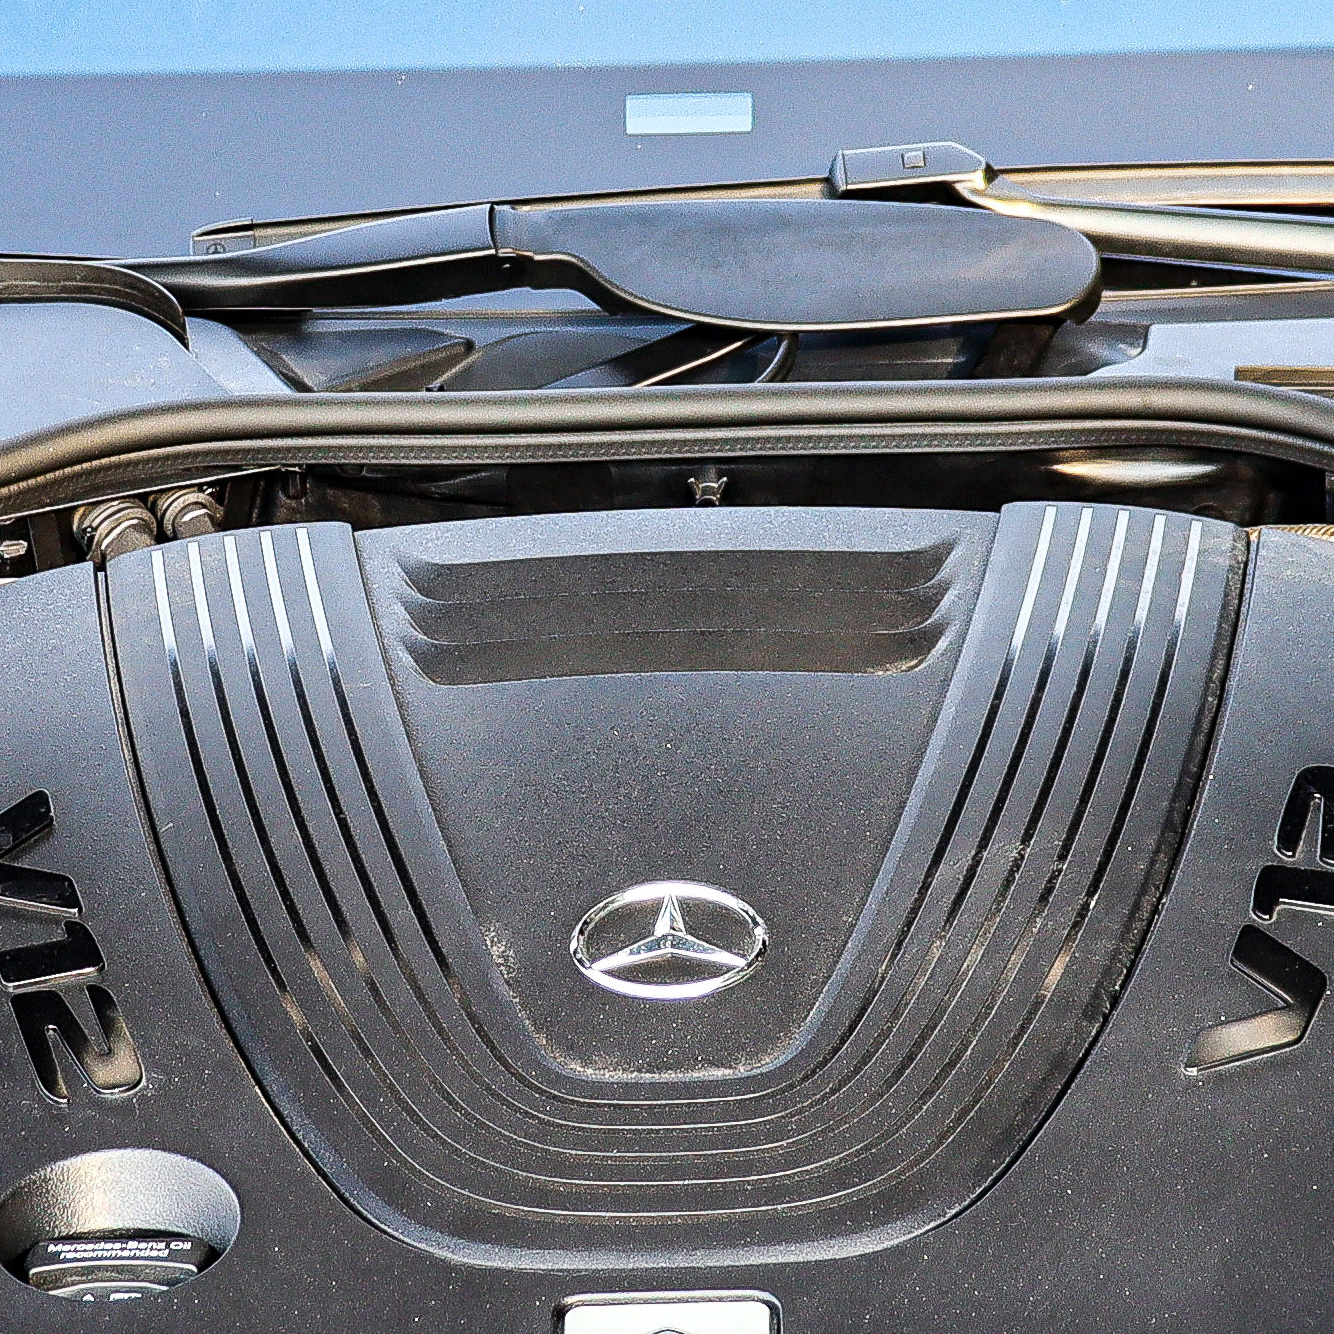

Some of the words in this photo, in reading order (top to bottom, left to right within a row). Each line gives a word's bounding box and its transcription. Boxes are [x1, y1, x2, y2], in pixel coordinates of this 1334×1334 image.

[47, 1241, 167, 1253] Mercedes-Benz
[169, 1240, 192, 1250] Oil
[59, 1248, 170, 1260] recommended
